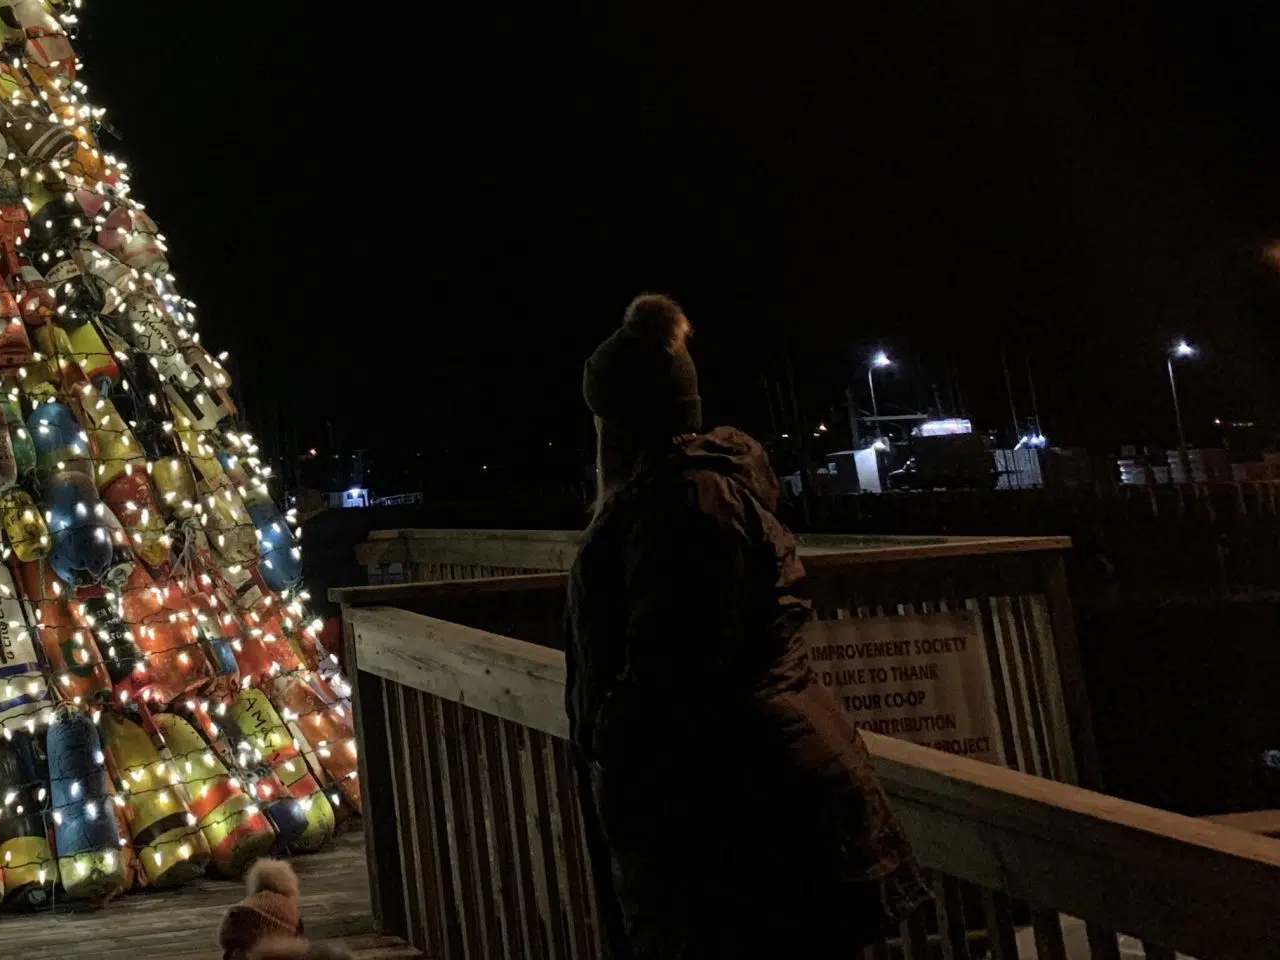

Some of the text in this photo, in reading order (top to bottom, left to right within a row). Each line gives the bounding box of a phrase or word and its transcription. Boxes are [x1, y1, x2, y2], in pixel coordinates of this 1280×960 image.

[811, 637, 967, 661] IMPROVEMENT SOCIETY
[835, 669, 866, 686] LIKE
[869, 667, 888, 684] TO
[890, 664, 940, 682] THANK
[842, 688, 926, 712] TOUR CO-OP
